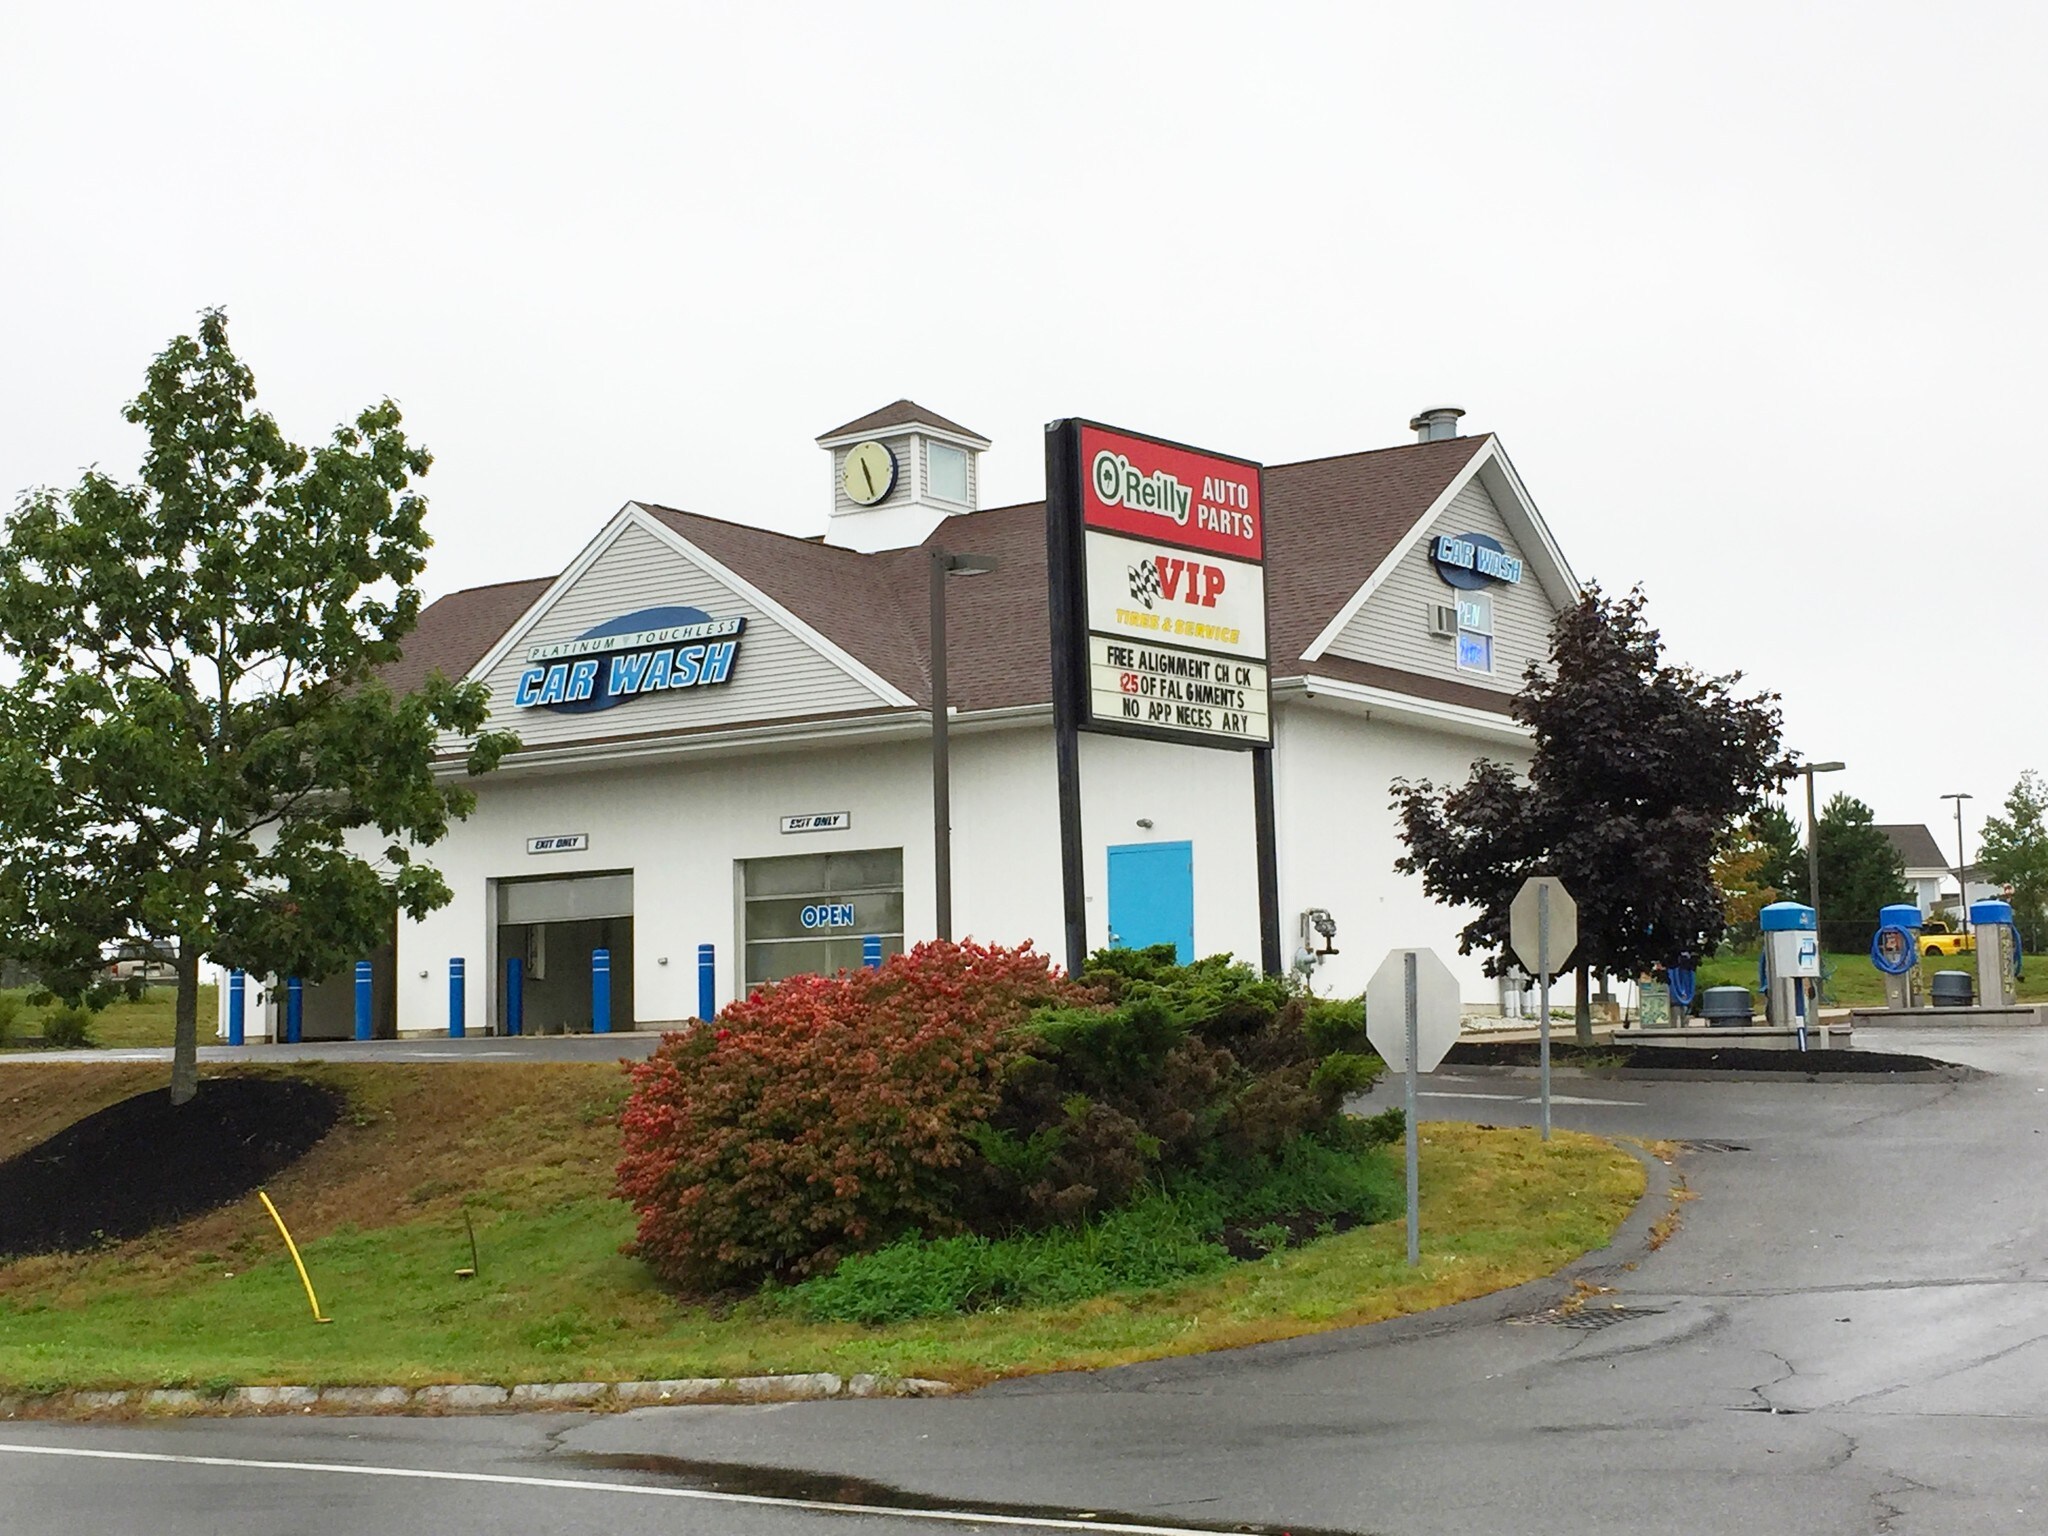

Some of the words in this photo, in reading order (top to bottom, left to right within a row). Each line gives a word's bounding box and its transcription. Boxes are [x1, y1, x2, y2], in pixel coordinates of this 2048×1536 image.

[1096, 455, 1189, 521] O'Reilly
[1202, 475, 1249, 510] AUTO
[1197, 503, 1254, 540] PARTS
[1437, 535, 1475, 570] CAR
[1476, 546, 1523, 584] WASH
[1154, 555, 1226, 608] VIP
[1116, 608, 1160, 631] TIRES
[1161, 617, 1172, 632] &
[1174, 619, 1241, 644] SERVICE
[1459, 600, 1481, 628] PEN
[531, 637, 616, 659] PLATINUM
[635, 619, 736, 645] TOUCHLESS
[514, 660, 599, 708] CAR
[607, 641, 737, 697] WASH
[1107, 645, 1134, 669] FREE
[1138, 650, 1210, 681] ALIGNMENT
[1122, 697, 1140, 718] NO
[1148, 702, 1172, 723] APP
[788, 817, 812, 829] EXIT
[813, 815, 840, 827] ONLY
[535, 839, 555, 850] EXIT
[555, 836, 579, 848] ONLY
[800, 903, 854, 929] OPEN
